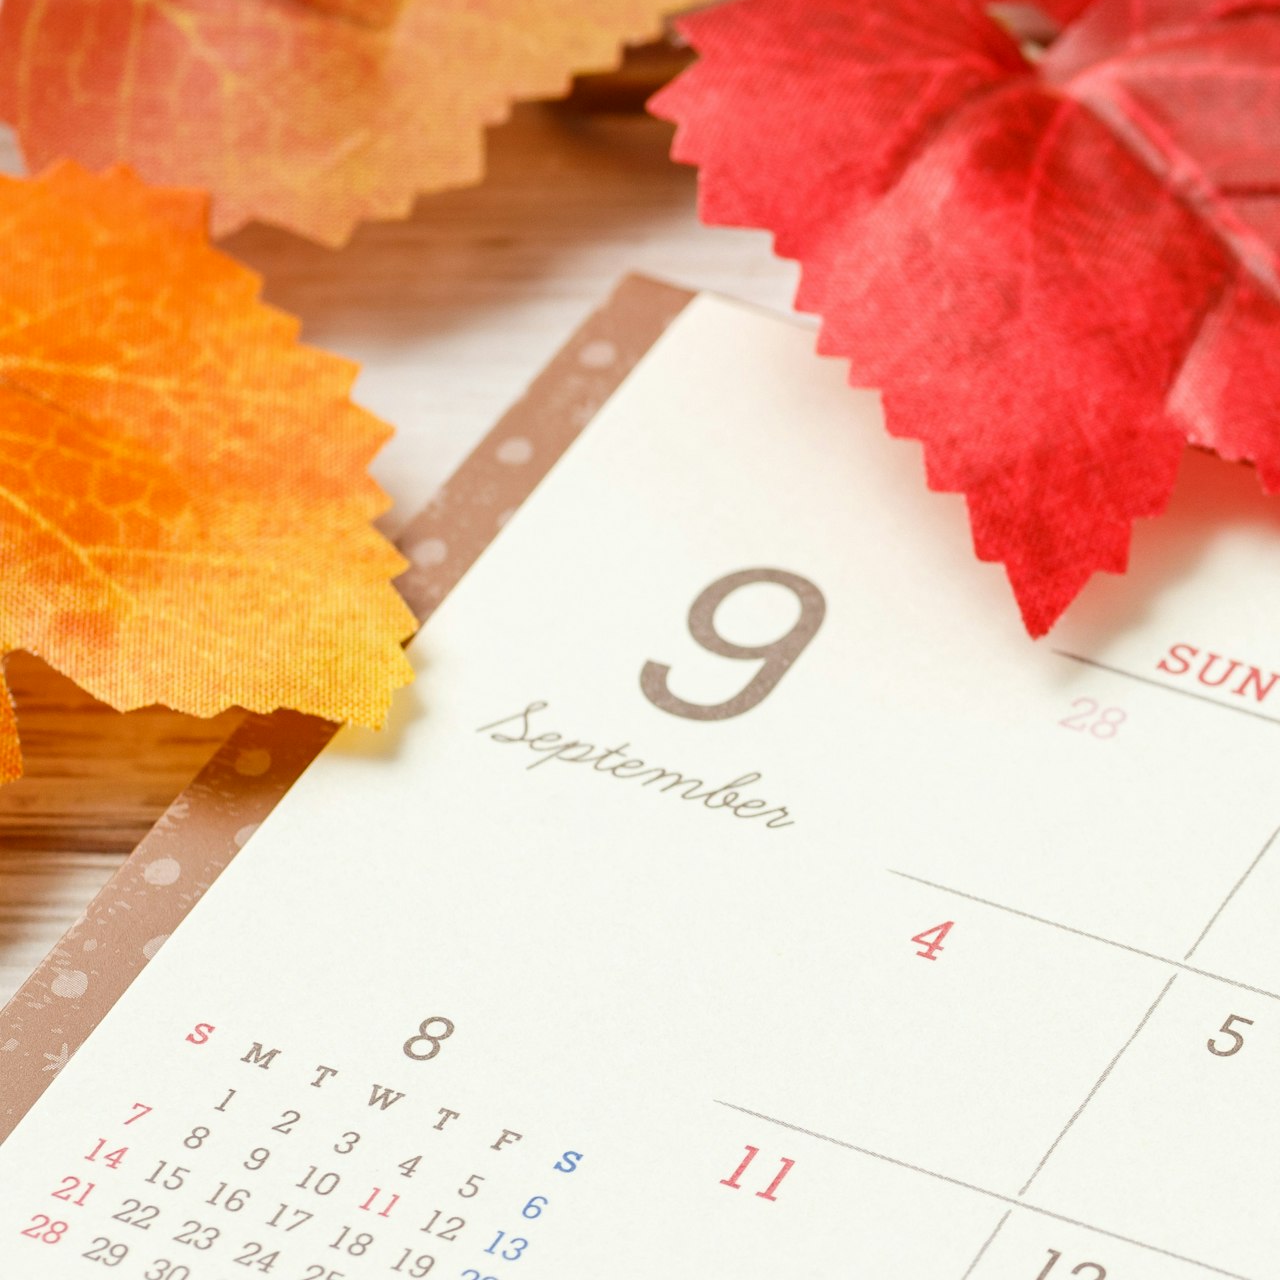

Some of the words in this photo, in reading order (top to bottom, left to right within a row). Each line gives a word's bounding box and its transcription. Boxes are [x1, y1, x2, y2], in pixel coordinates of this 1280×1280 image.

[638, 565, 828, 724] 9
[476, 700, 796, 830] September
[1056, 696, 1128, 741] 28
[402, 1015, 456, 1062] 8
[908, 919, 957, 963] 4
[1206, 1012, 1260, 1058] 5
[184, 1022, 216, 1046] S
[239, 1041, 283, 1070] M
[310, 1064, 339, 1089] T
[367, 1083, 406, 1112] W
[432, 1107, 461, 1132] T
[489, 1128, 523, 1152] F
[553, 1150, 584, 1174] S
[213, 1088, 237, 1113] 1
[271, 1109, 301, 1135] 2
[333, 1130, 362, 1155] 3
[397, 1154, 424, 1179] 4
[457, 1173, 486, 1199] 5
[521, 1195, 549, 1220] 6
[50, 1175, 96, 1207] 21
[111, 1198, 161, 1231] 22
[172, 1219, 221, 1251] 23
[232, 1241, 281, 1274] 24
[83, 1137, 129, 1170] 14
[144, 1159, 191, 1191] 15
[204, 1181, 251, 1213] 16
[264, 1202, 315, 1232] 17
[327, 1225, 374, 1257] 18
[389, 1247, 436, 1279] 19
[123, 1102, 153, 1127] 7
[182, 1125, 211, 1150] 8
[242, 1146, 271, 1171] 9
[294, 1165, 341, 1196] 10
[358, 1186, 401, 1218] 11
[419, 1209, 467, 1242] 12
[482, 1230, 529, 1262] 13
[718, 1144, 796, 1203] 11
[20, 1213, 69, 1245] 28
[81, 1236, 130, 1267] 29
